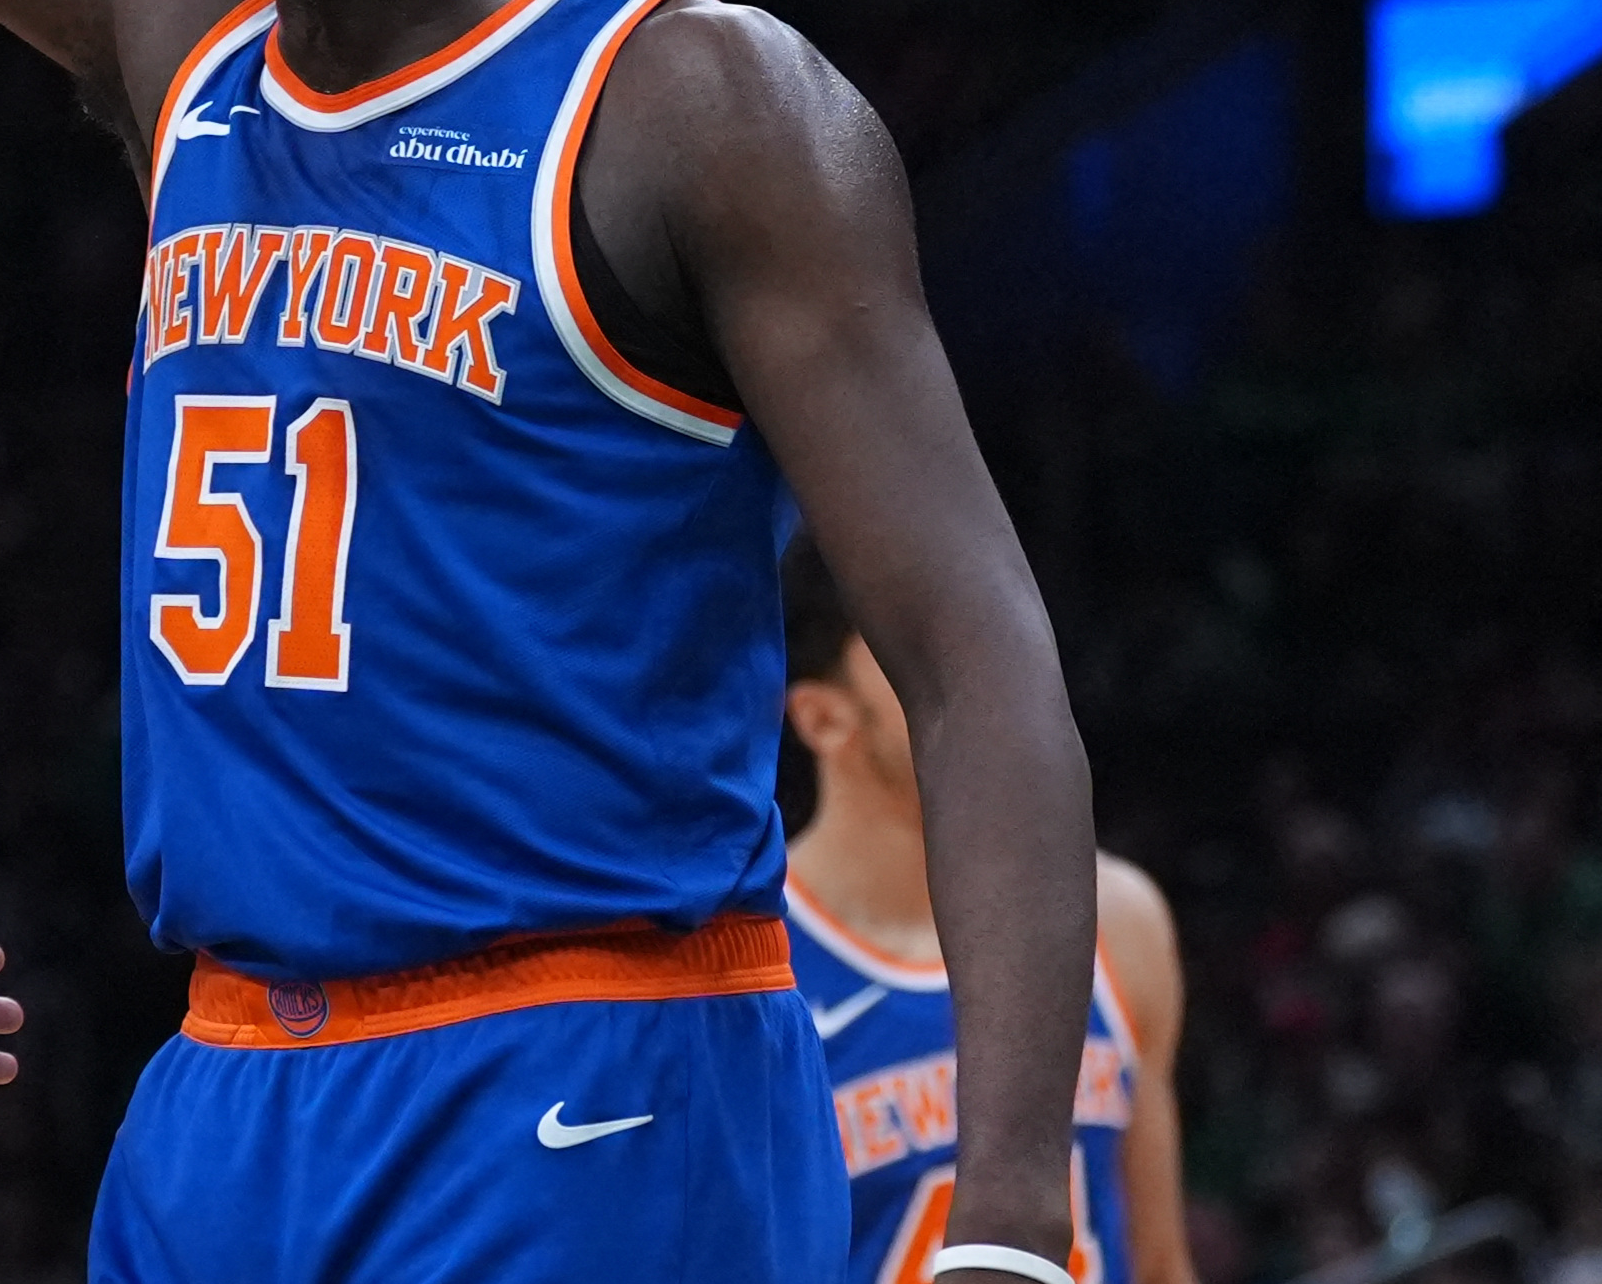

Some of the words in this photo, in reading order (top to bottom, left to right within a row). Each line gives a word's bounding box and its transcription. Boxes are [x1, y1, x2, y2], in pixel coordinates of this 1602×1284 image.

[399, 125, 471, 142] experience
[389, 137, 443, 161] abu
[150, 394, 357, 693] 51
